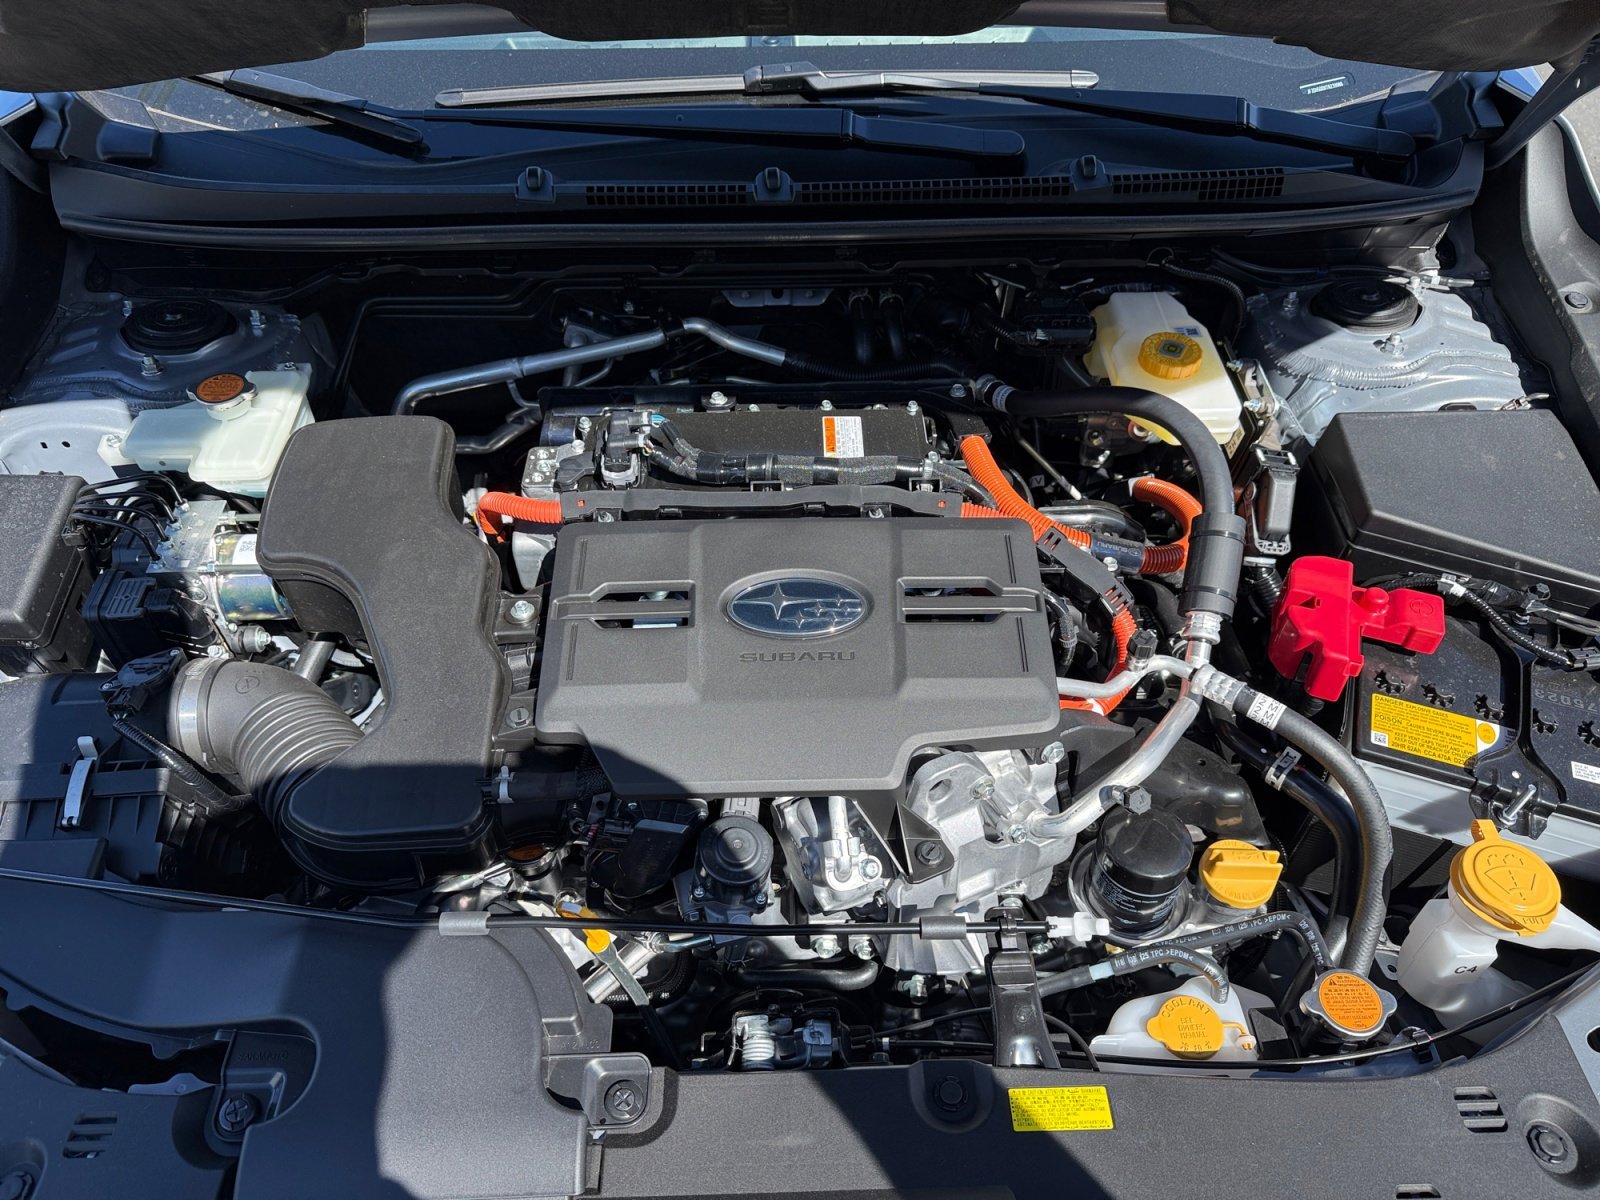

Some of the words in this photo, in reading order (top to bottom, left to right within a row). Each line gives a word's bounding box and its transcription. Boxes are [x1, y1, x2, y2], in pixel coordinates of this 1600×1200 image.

[739, 651, 855, 663] SUBARU
[1374, 695, 1404, 707] DANGER
[1405, 703, 1432, 714] EXPLOSIVE
[1432, 709, 1449, 718] GASES
[1374, 713, 1403, 725] POISON
[1406, 720, 1426, 731] CAUSES
[1426, 726, 1445, 736] SEVERE
[1445, 731, 1462, 741] BURNS
[1421, 738, 1435, 746] CAPS
[1435, 742, 1450, 750] TIGHT
[1426, 745, 1443, 753] REACH
[1391, 742, 1406, 750] 20HR
[1423, 749, 1437, 758] CCA
[1437, 753, 1452, 762] 470A
[1150, 948, 1164, 958] TPC
[1454, 965, 1478, 974] C4
[1161, 998, 1212, 1018] COOLANT
